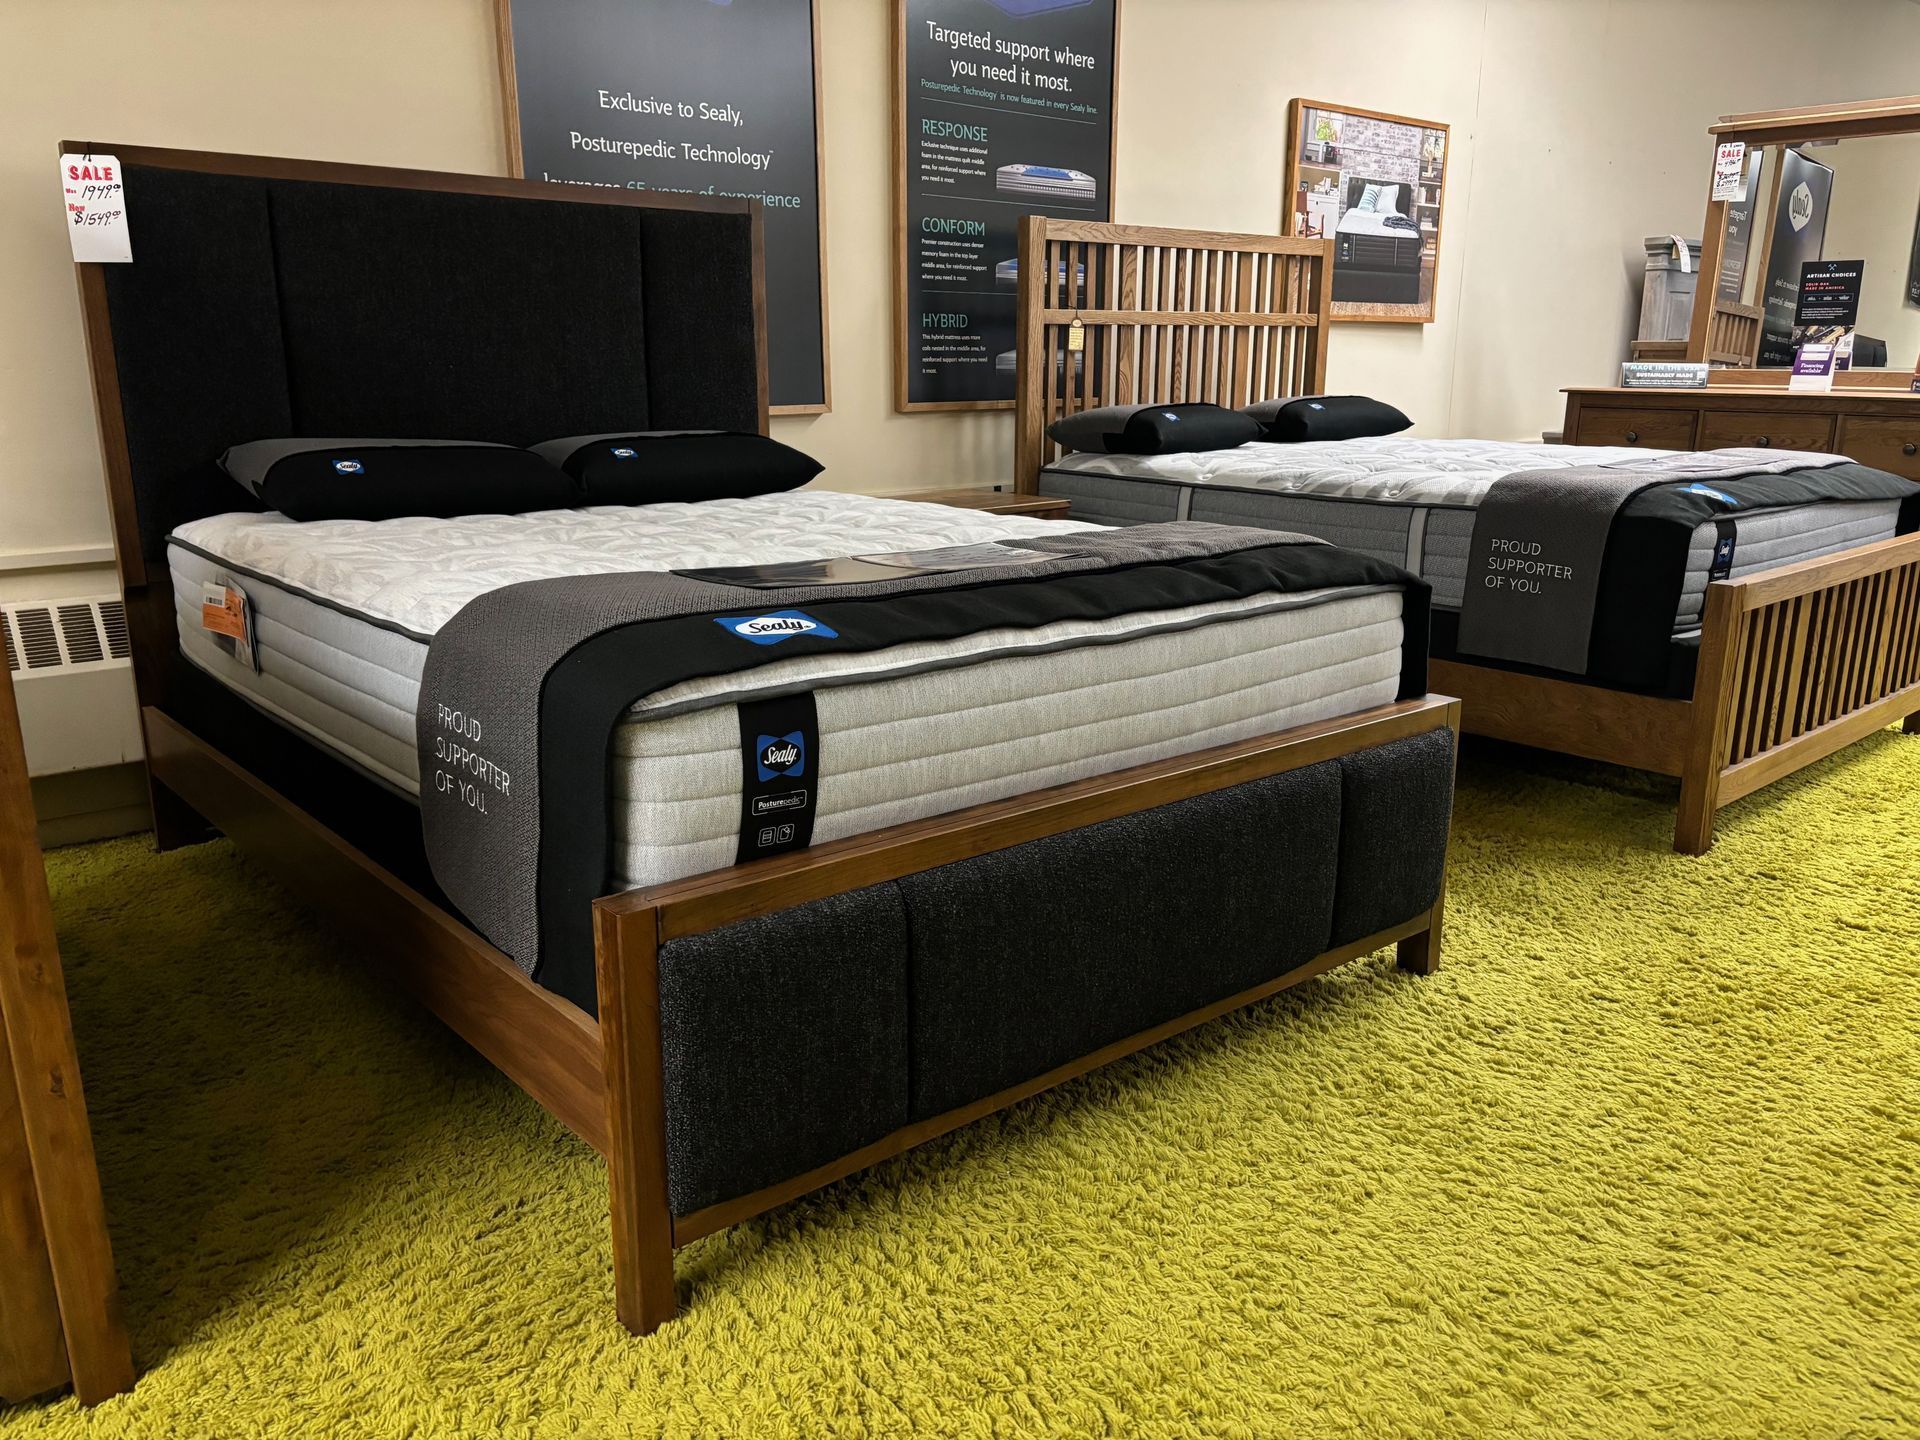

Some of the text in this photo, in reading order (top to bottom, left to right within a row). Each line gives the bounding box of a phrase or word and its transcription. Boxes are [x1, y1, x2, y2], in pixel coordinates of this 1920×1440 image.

[926, 20, 1095, 70] Targeted support where
[950, 58, 1072, 92] you need it most.
[920, 78, 960, 93] Posturepedic
[1000, 92, 1006, 100] is
[1020, 95, 1045, 106] featured
[1053, 102, 1070, 111] every
[1070, 102, 1086, 113] Sealy
[598, 90, 744, 126] Exclusive to Sealy,
[921, 118, 988, 142] RESPONSE
[570, 131, 676, 160] Posturepedic
[1721, 150, 1741, 158] SALE
[68, 165, 113, 181] SALE
[68, 203, 85, 212] Now
[922, 217, 985, 236] CONFORM
[922, 313, 968, 328] HYBRID
[1491, 538, 1542, 555] PROUD
[1487, 557, 1573, 580] SUPPORTER
[1485, 575, 1542, 594] OF YOU.
[748, 619, 804, 633] Sealy
[438, 703, 481, 742] PROUD
[764, 744, 797, 765] Sealy
[435, 737, 510, 796] SUPPORTER
[436, 770, 488, 815] OF YOU.
